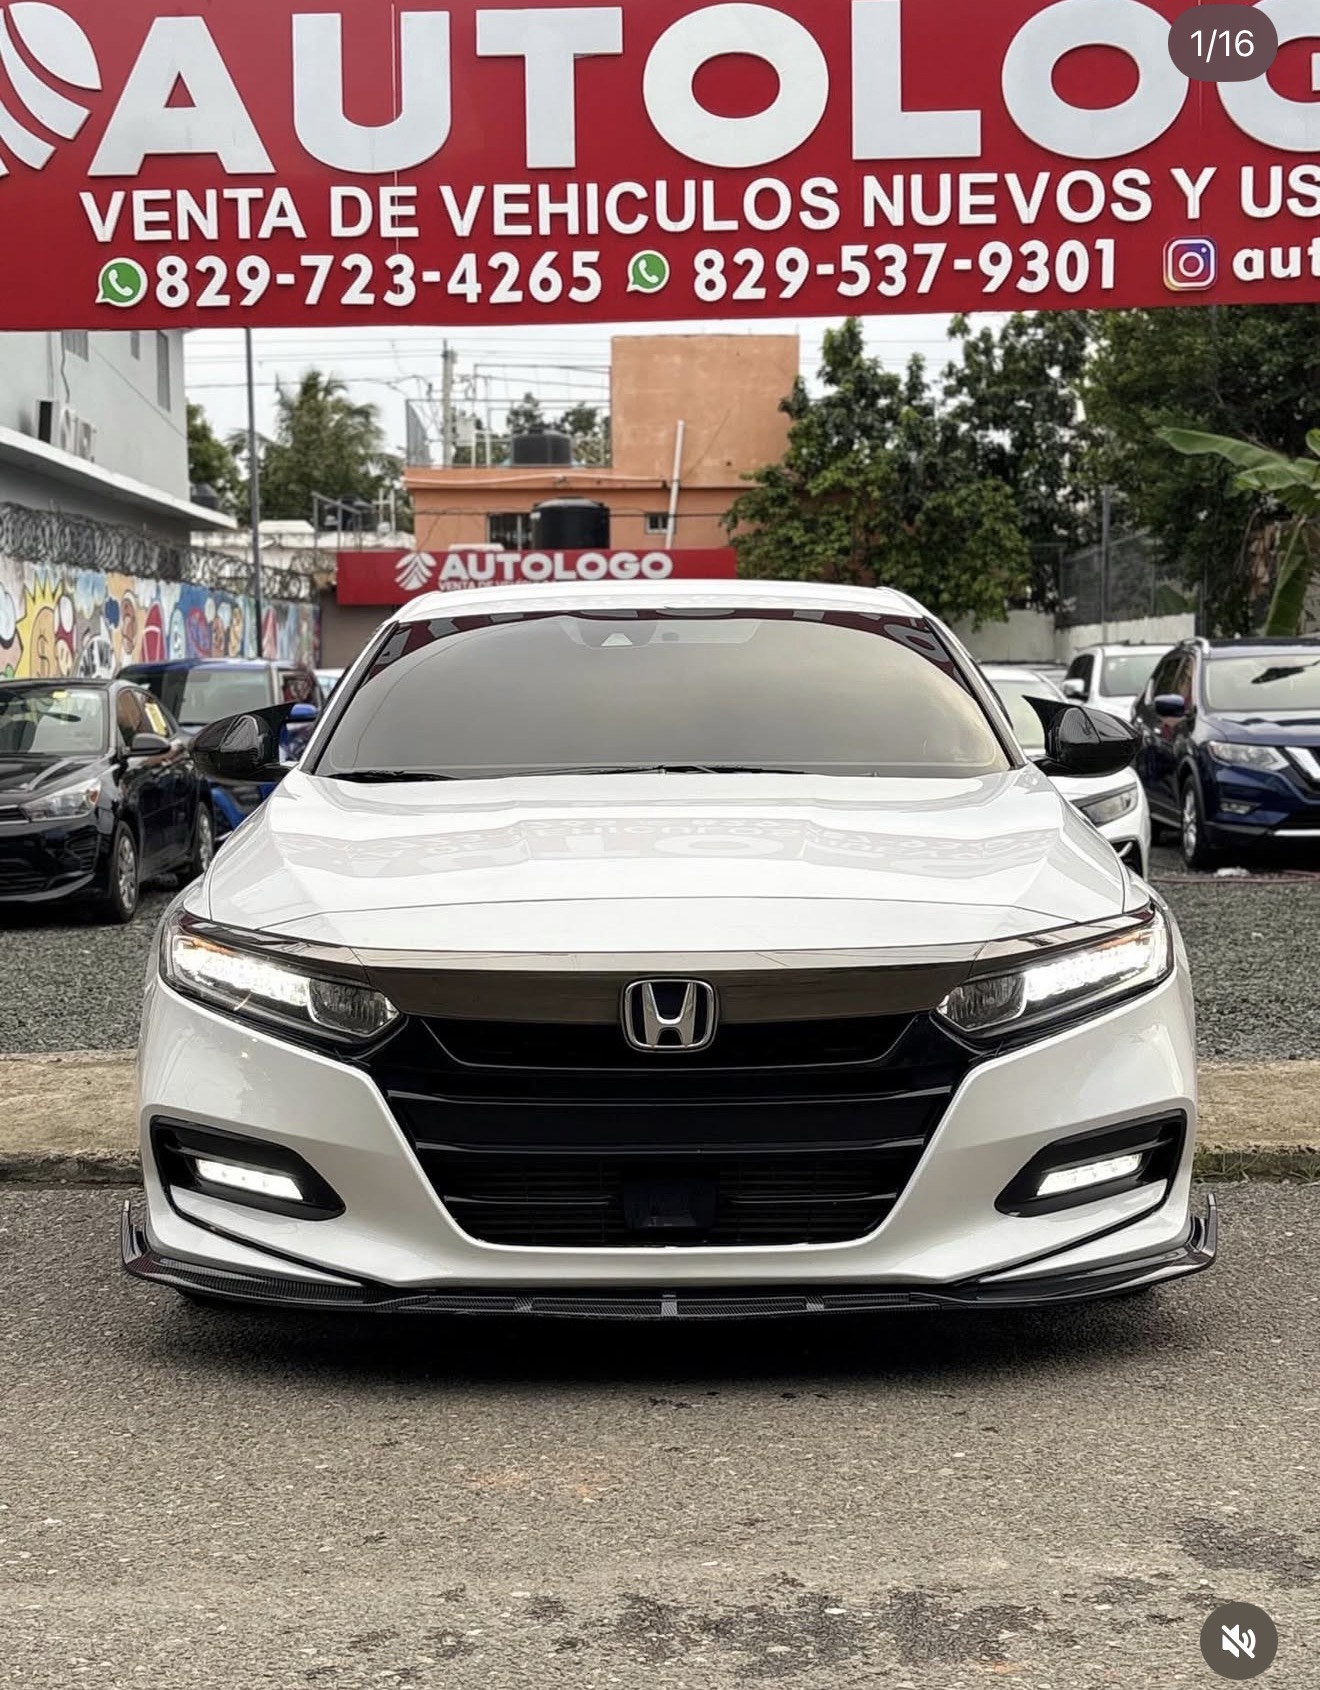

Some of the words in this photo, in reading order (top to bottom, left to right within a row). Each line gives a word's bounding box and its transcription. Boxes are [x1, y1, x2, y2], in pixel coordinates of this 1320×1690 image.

[79, 187, 307, 242] VENTA
[330, 185, 419, 238] DE
[440, 176, 840, 238] VEHICULOS
[863, 168, 1152, 227] NUEVOS
[1171, 167, 1217, 219] Y
[155, 250, 602, 308] 829-723-4265
[693, 238, 1115, 302] 829-537-9301
[438, 552, 673, 580] AUTOLOGO
